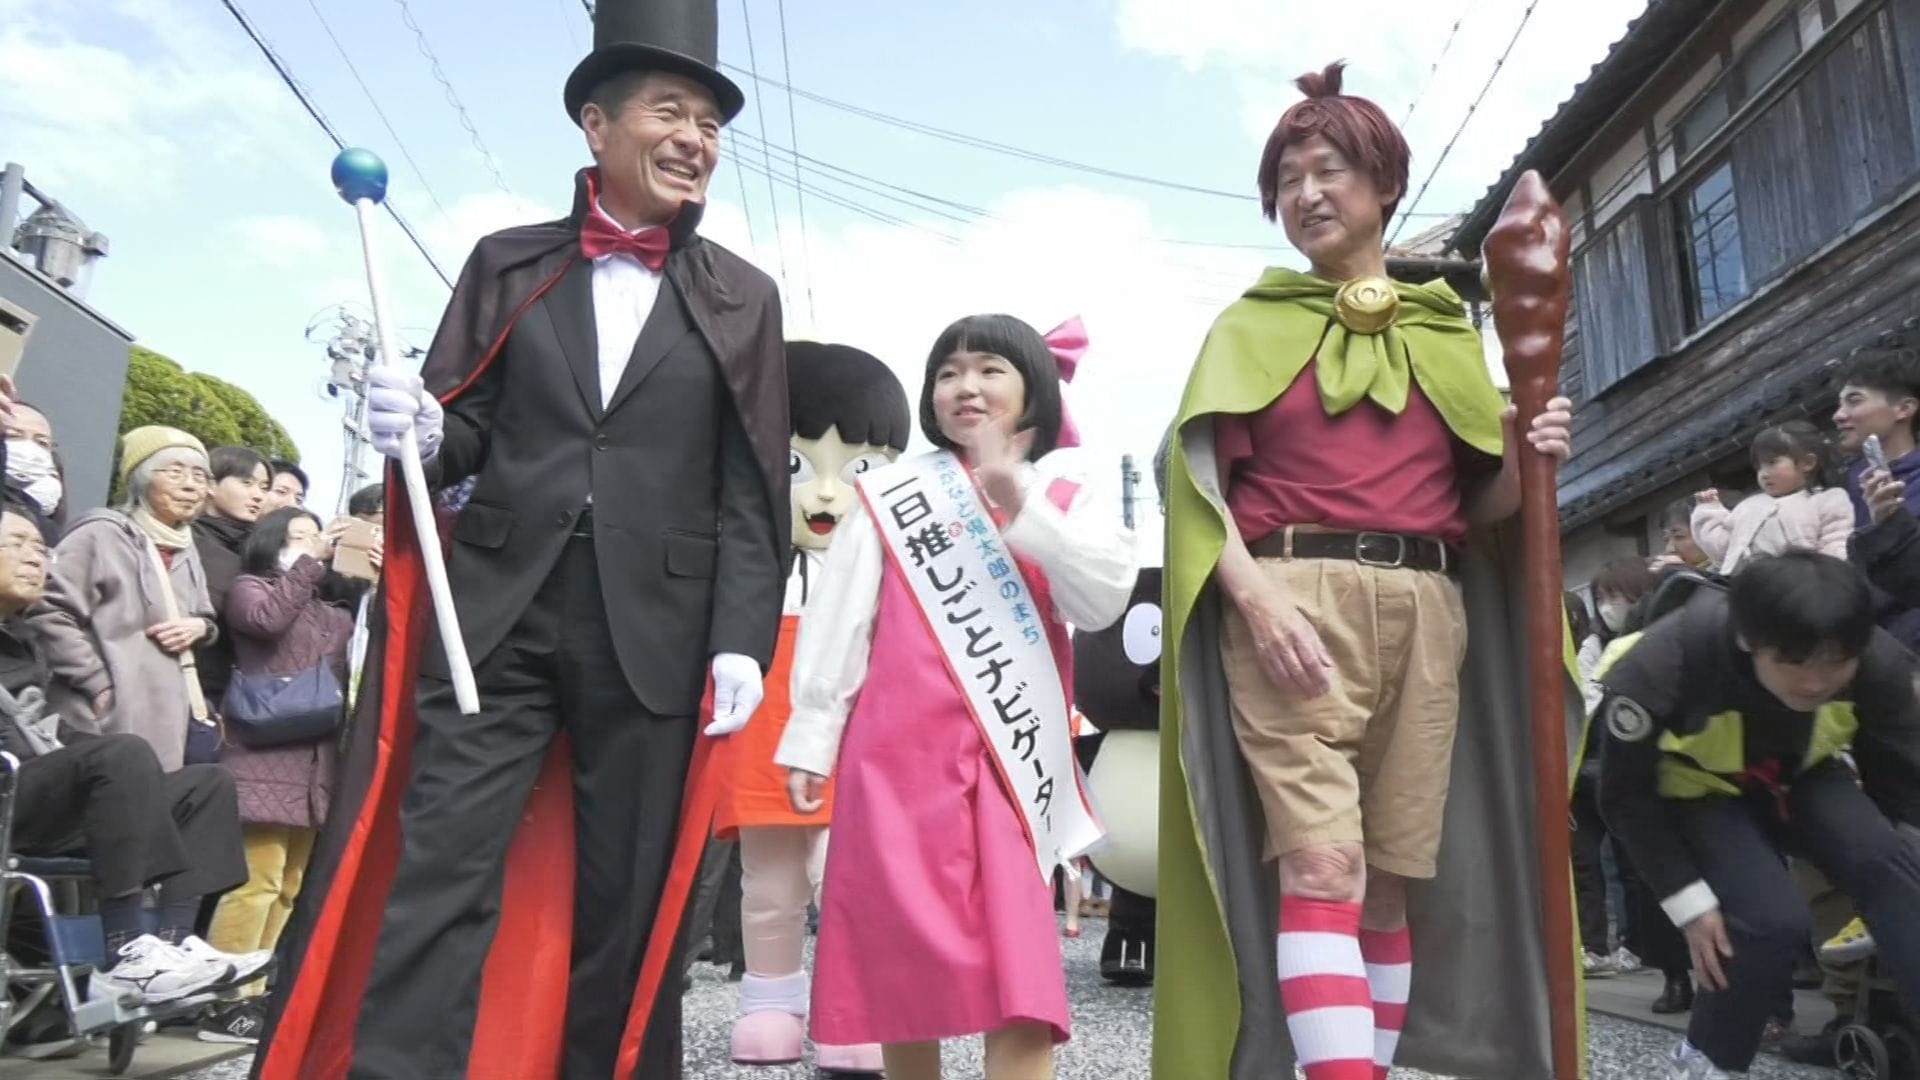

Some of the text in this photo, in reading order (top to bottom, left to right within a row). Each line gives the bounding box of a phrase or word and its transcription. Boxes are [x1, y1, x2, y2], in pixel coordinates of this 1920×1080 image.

[880, 476, 1053, 832] 一日推しごとナビゲーター
